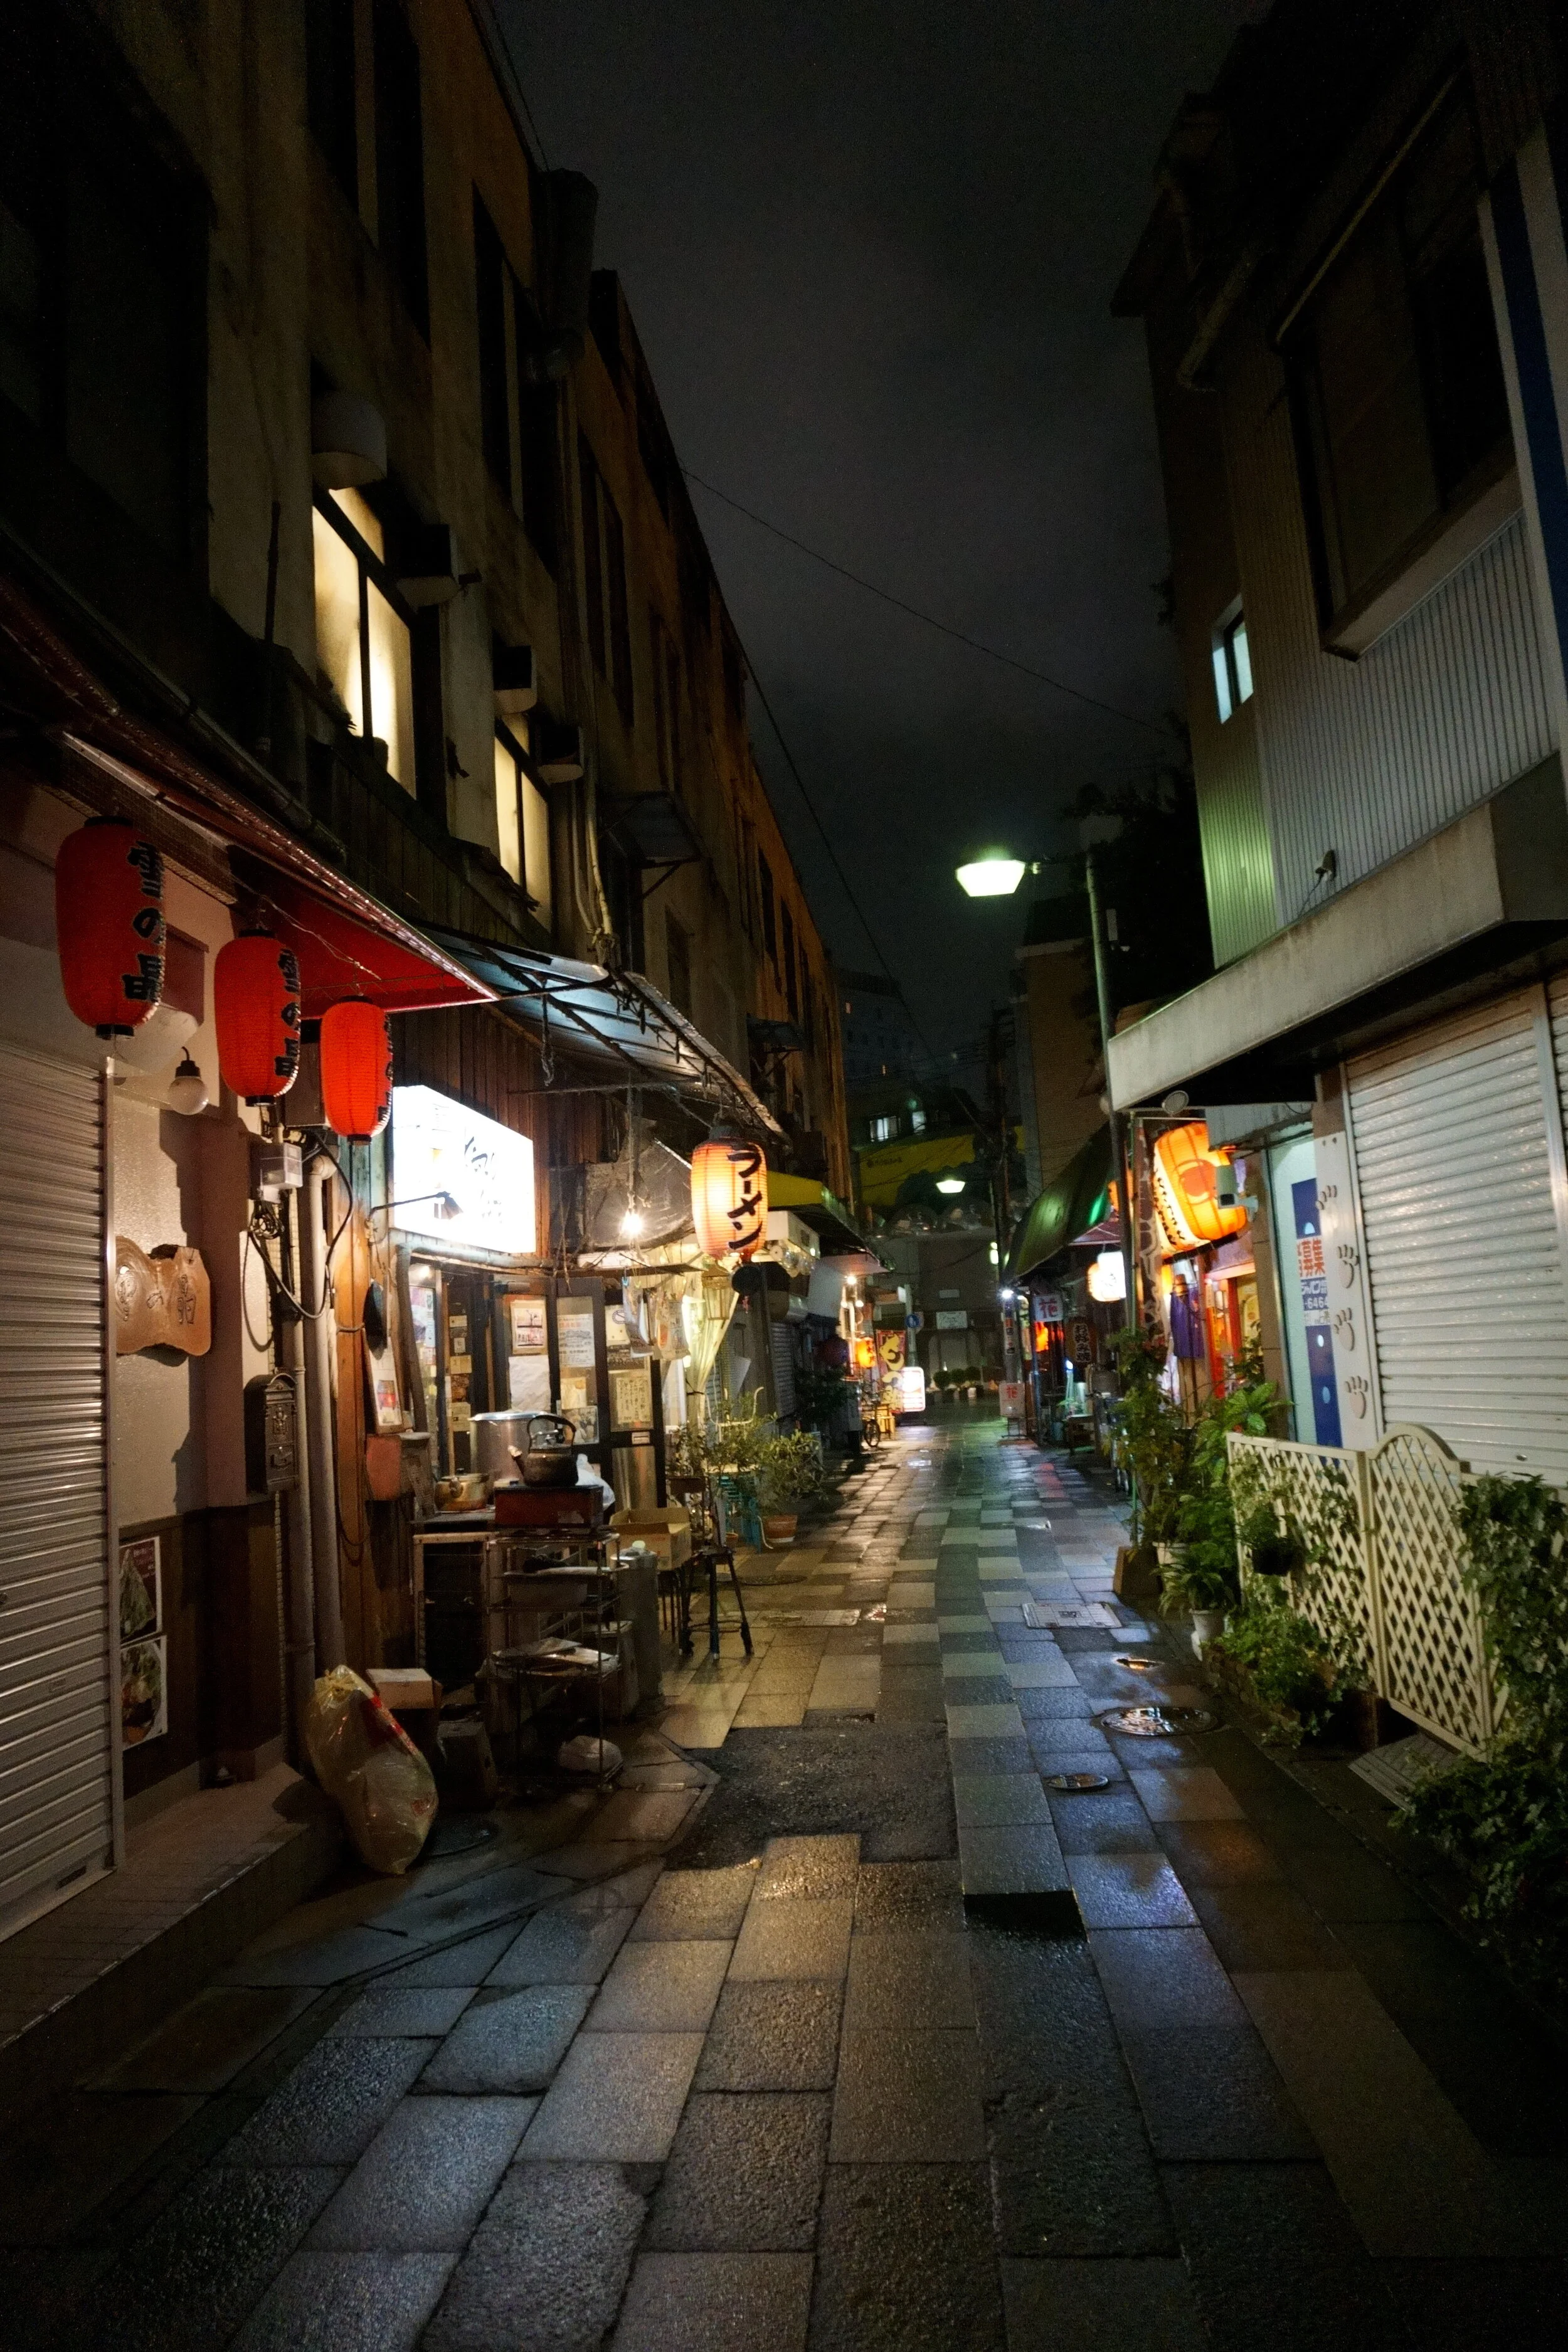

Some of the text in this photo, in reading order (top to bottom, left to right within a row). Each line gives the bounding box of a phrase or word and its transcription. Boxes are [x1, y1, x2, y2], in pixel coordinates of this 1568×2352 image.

[726, 1152, 763, 1250] ラーメン
[1039, 1298, 1059, 1318] 花
[1005, 1385, 1019, 1399] 花
